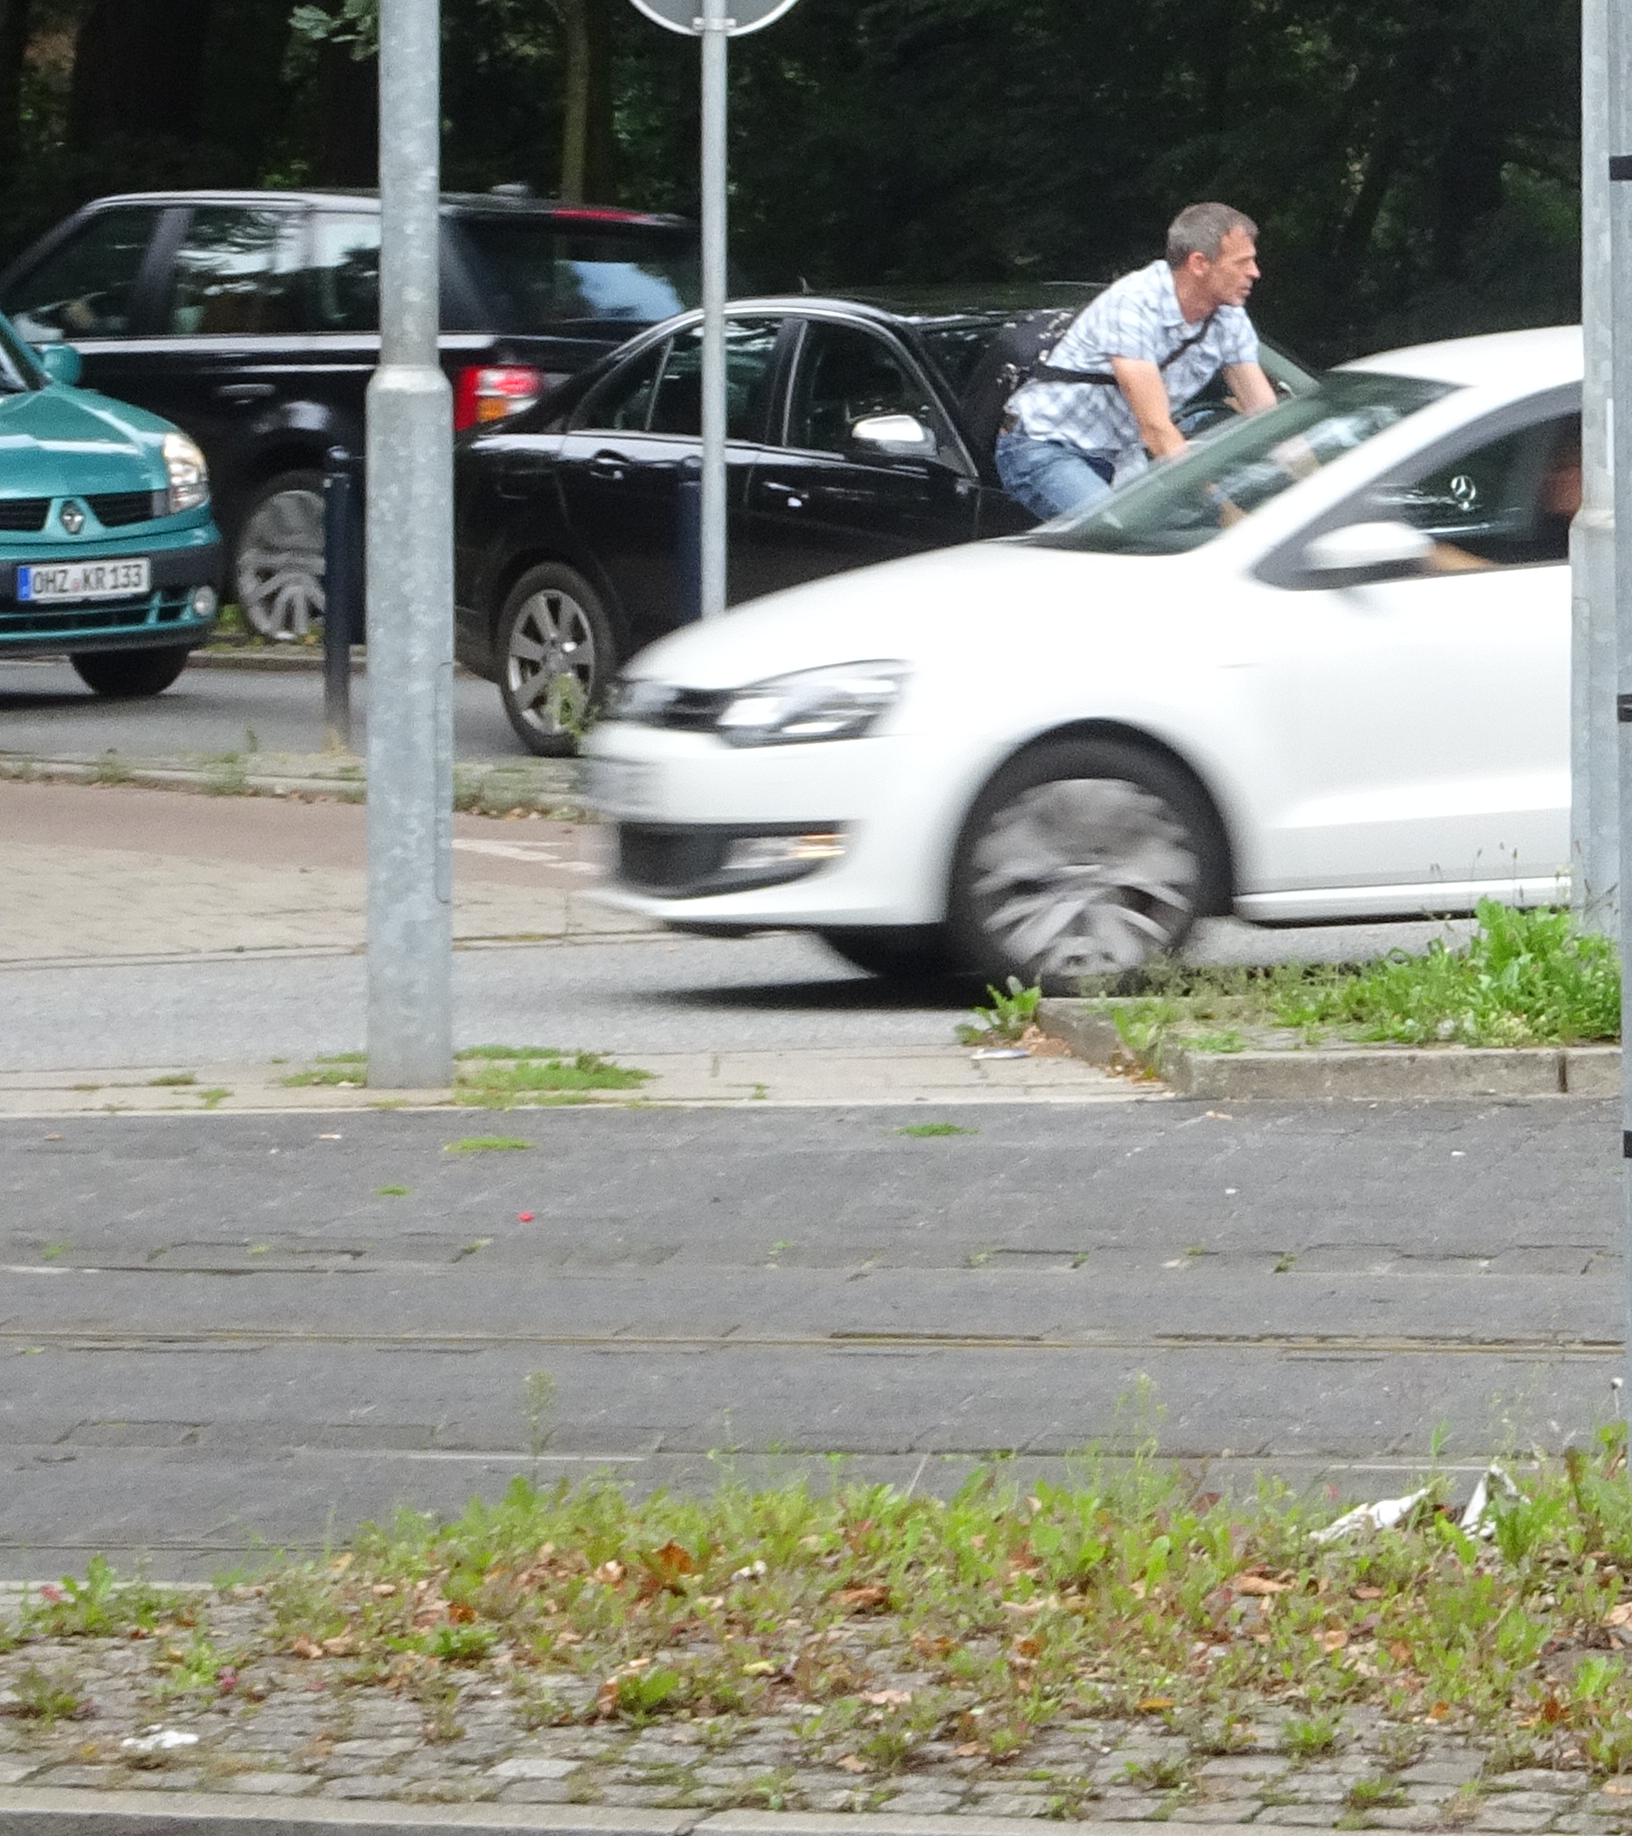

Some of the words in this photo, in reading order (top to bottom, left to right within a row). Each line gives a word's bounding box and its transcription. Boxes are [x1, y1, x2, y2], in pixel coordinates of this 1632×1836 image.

[33, 568, 68, 594] OHZ
[82, 567, 105, 591] KR
[110, 564, 142, 589] 133
